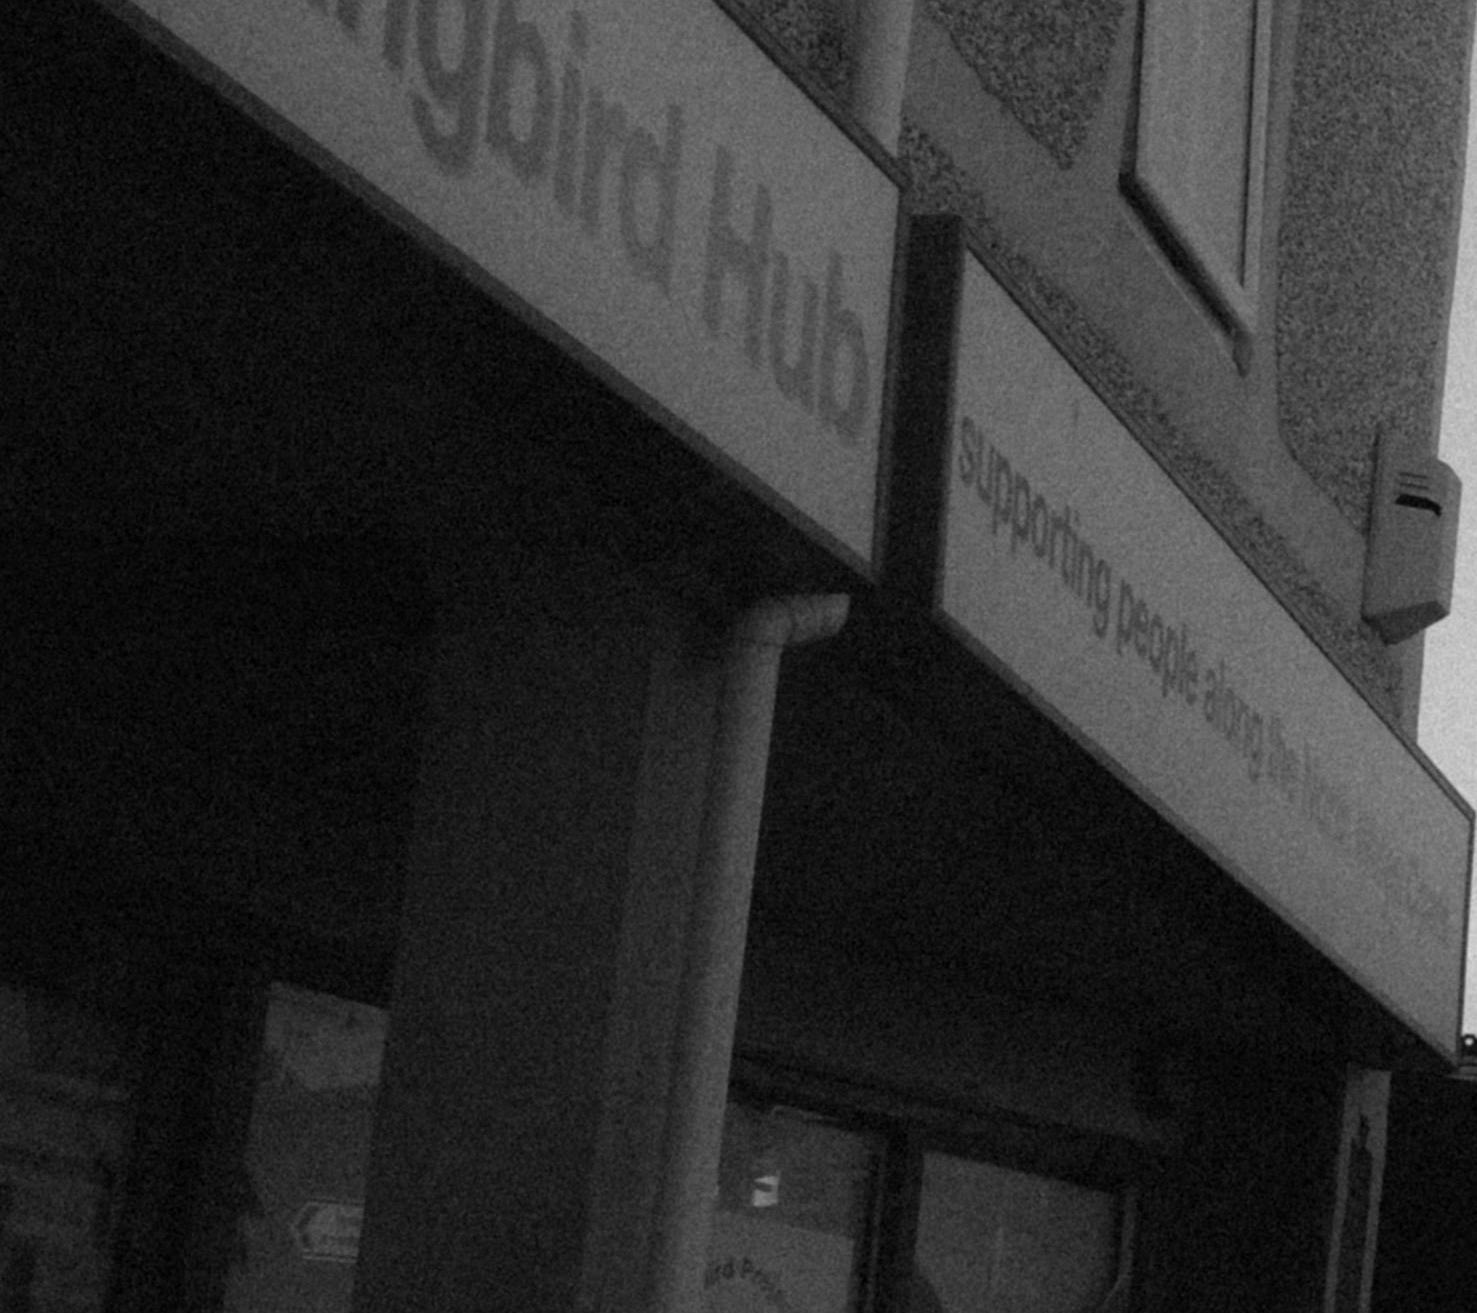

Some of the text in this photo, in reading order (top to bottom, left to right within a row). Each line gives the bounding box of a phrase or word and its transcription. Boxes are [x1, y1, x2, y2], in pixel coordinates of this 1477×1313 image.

[703, 142, 871, 448] Hub
[960, 414, 1112, 639] supporting
[1116, 577, 1199, 708] people
